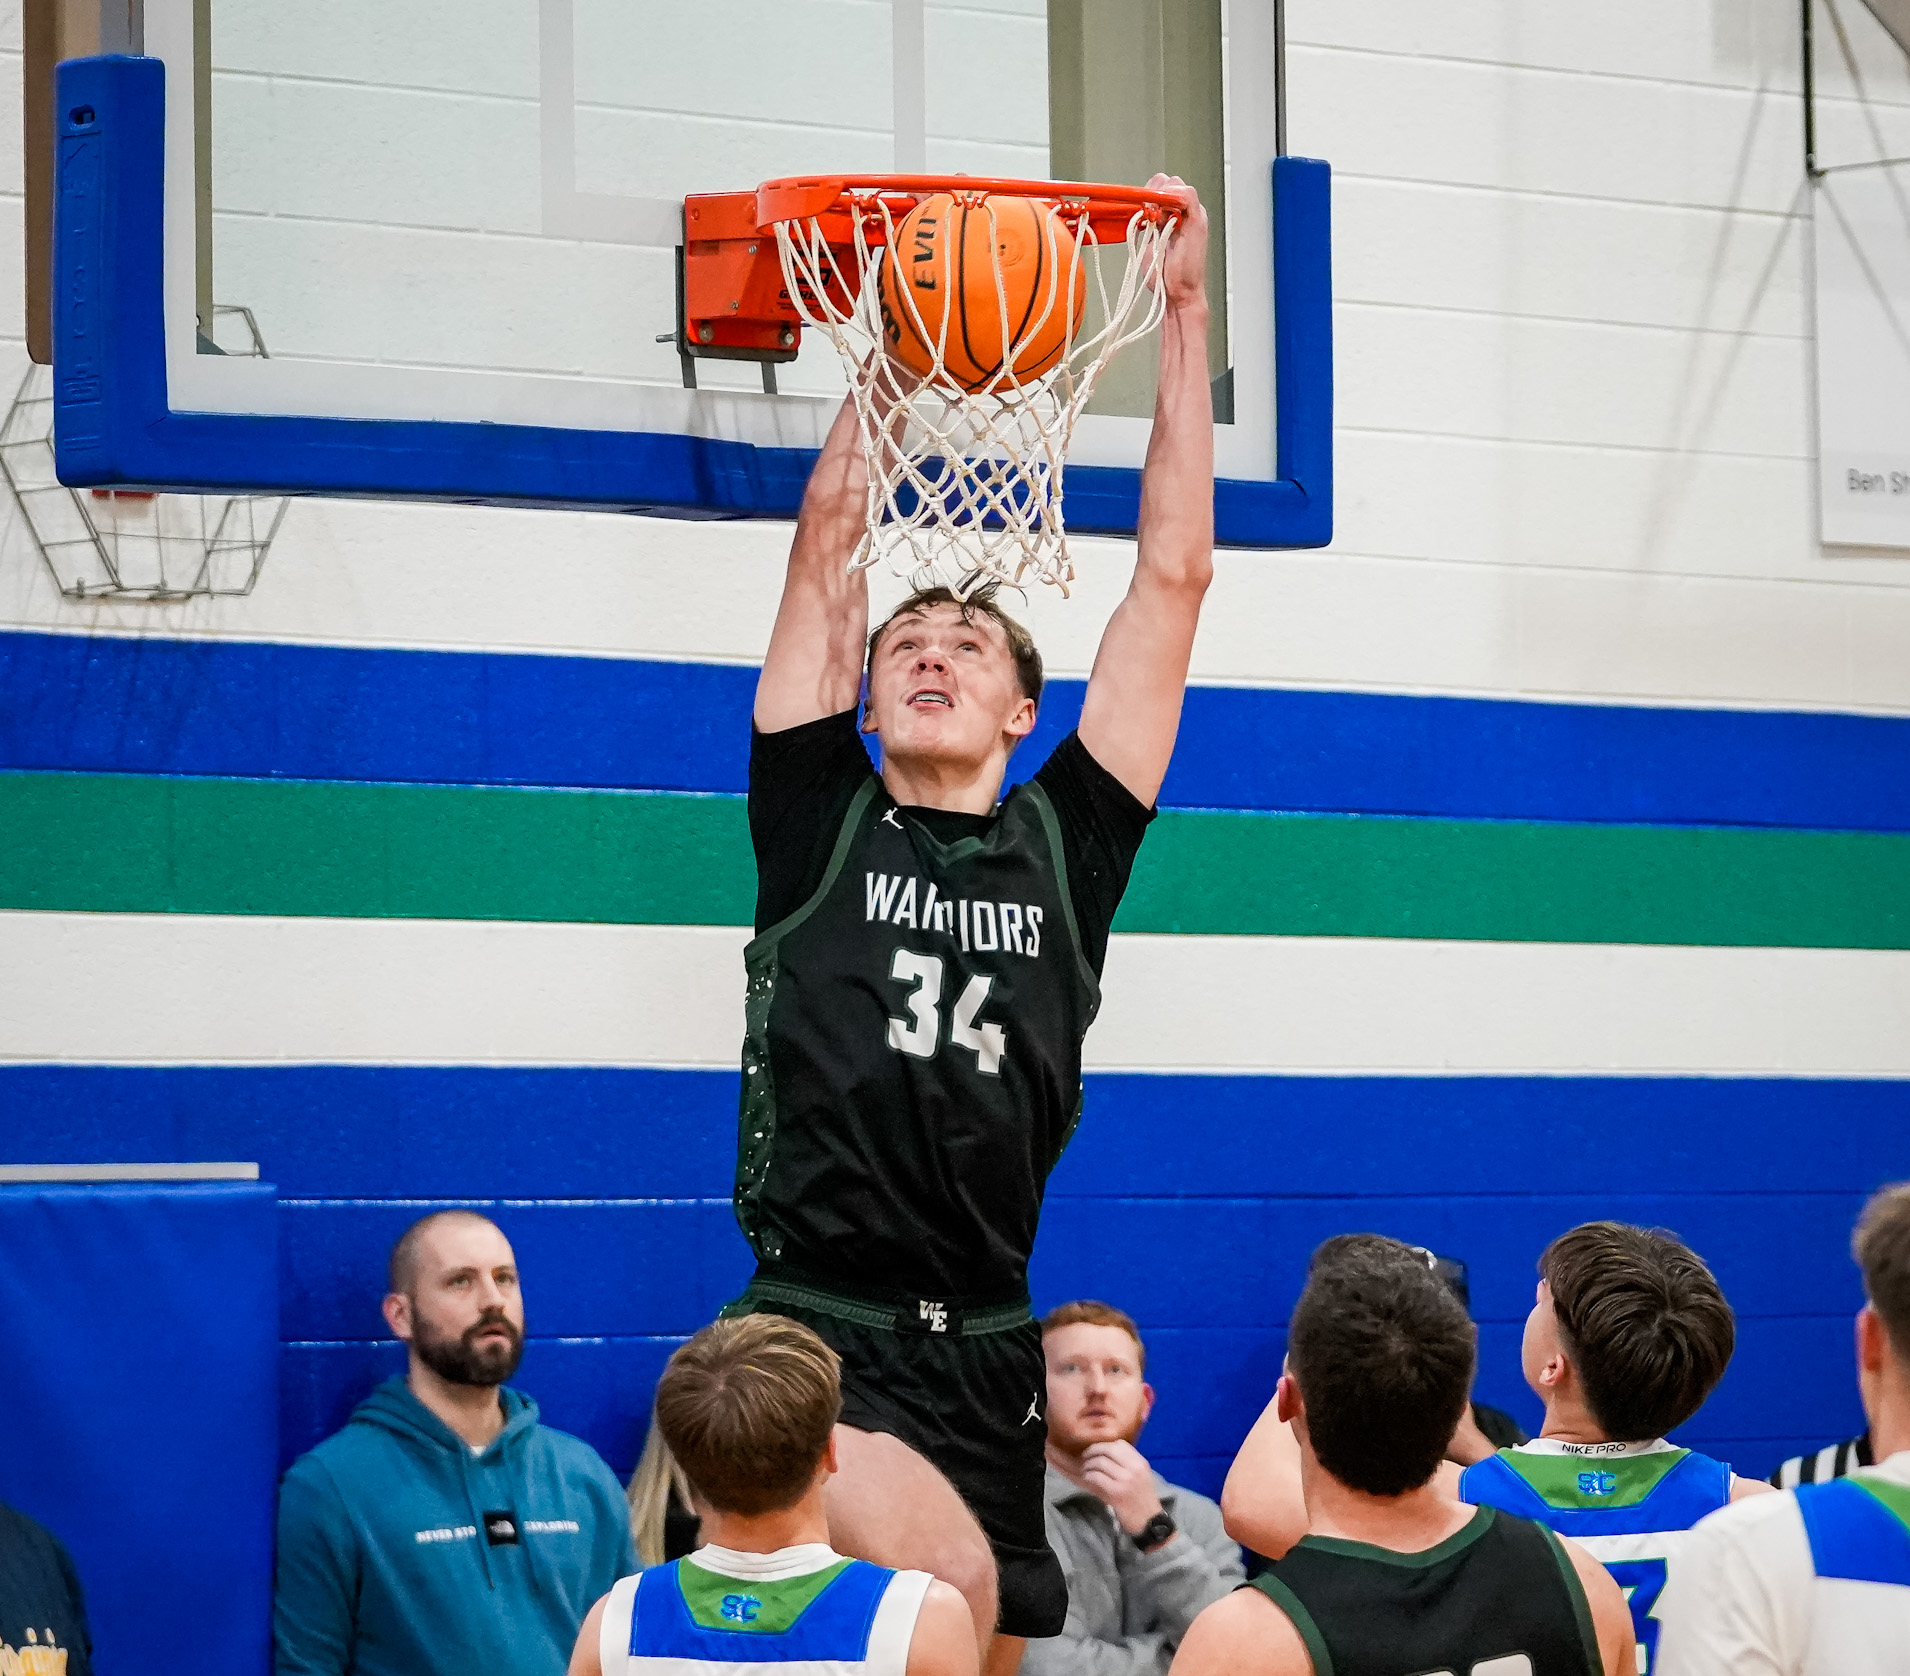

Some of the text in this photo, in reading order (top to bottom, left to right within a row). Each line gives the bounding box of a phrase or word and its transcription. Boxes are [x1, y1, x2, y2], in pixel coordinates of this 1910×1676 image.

[1847, 468, 1886, 493] Ben
[887, 947, 1007, 1075] 34
[919, 1300, 948, 1332] WE
[1561, 1443, 1627, 1455] NIKE PRO
